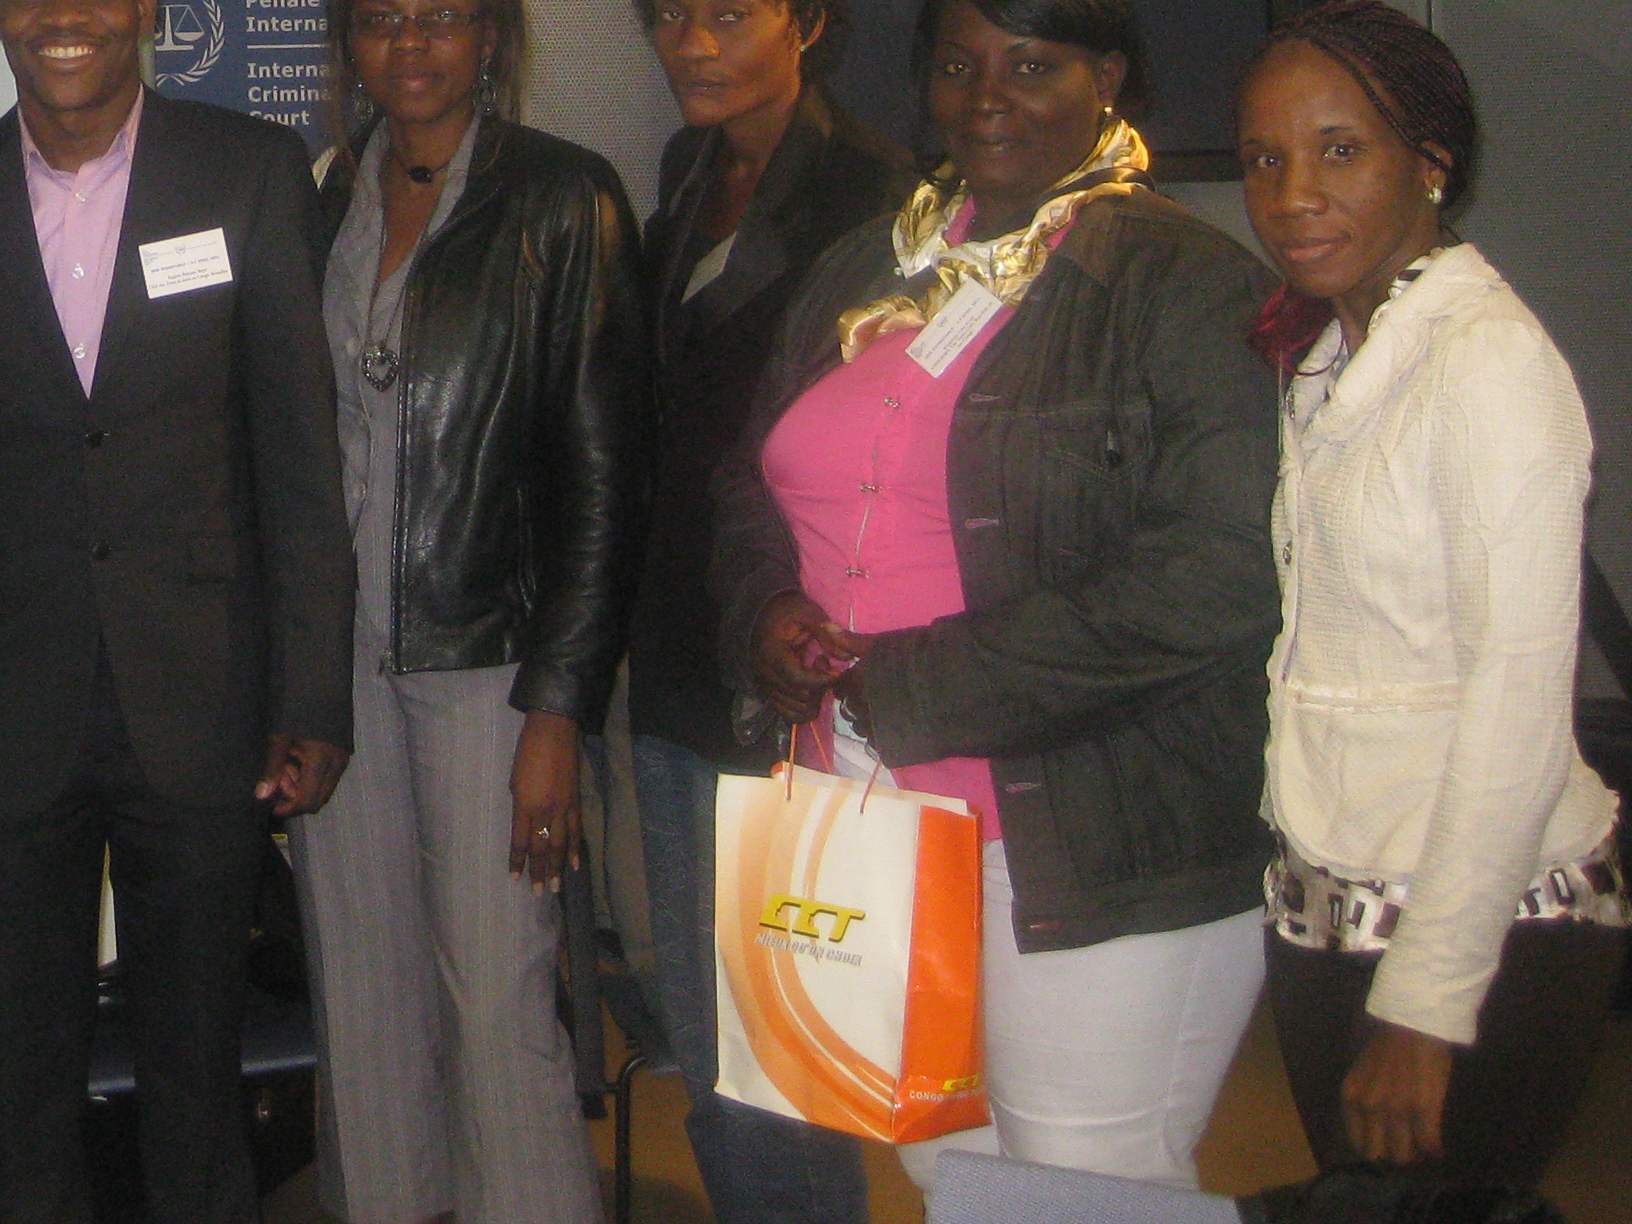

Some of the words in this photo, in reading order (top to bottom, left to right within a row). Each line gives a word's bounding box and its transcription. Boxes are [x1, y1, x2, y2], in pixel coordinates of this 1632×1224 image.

[245, 16, 328, 33] Interna
[247, 62, 331, 79] Interna
[247, 85, 331, 103] Crimina
[909, 1090, 944, 1102] CONGO
